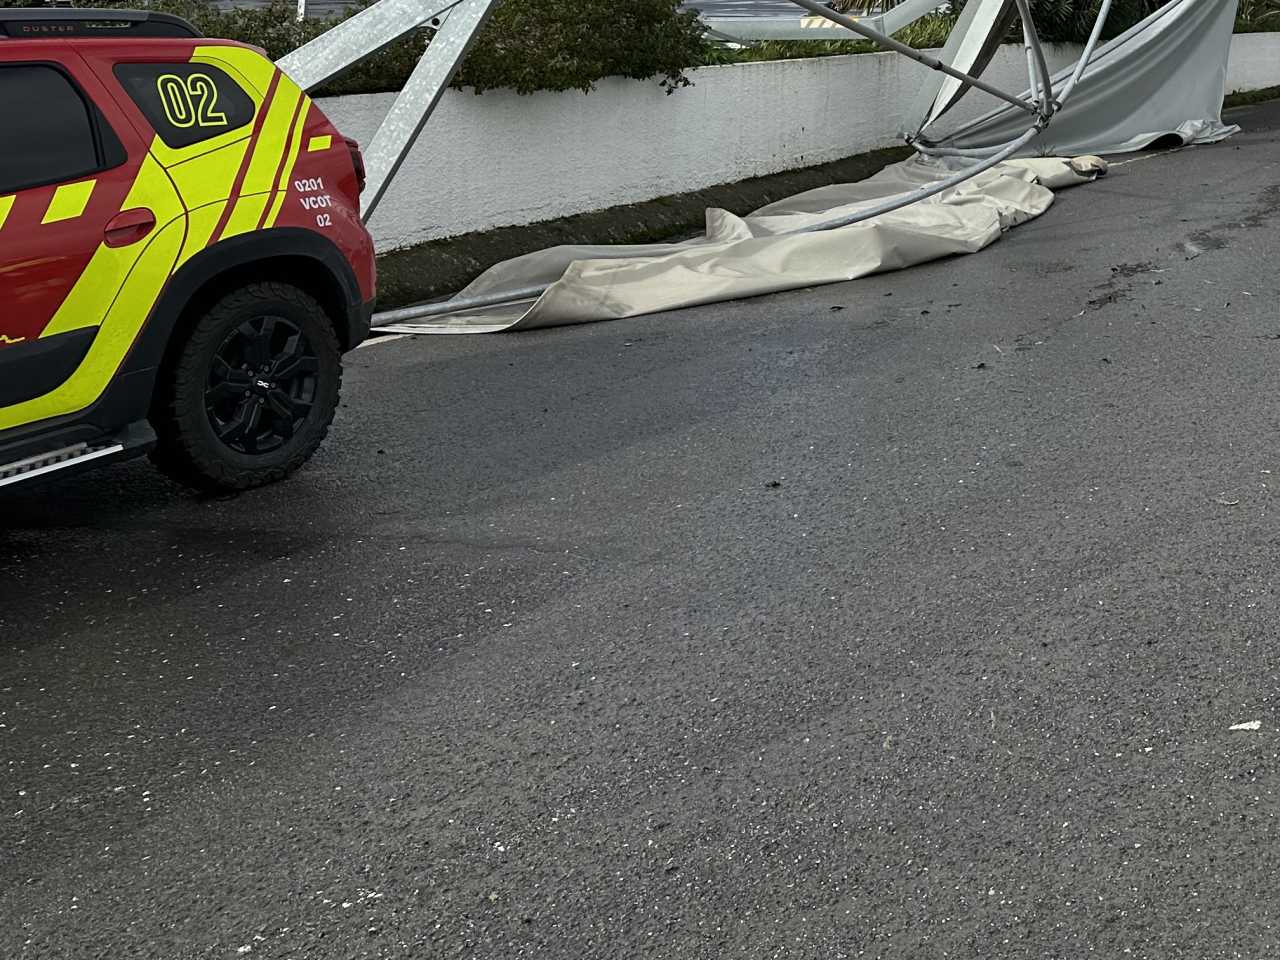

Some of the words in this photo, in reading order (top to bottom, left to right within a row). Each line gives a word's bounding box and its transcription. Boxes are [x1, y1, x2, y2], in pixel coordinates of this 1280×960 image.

[157, 73, 228, 127] 02
[294, 177, 324, 192] 0201
[300, 195, 332, 209] VCOT
[316, 214, 332, 227] 02
